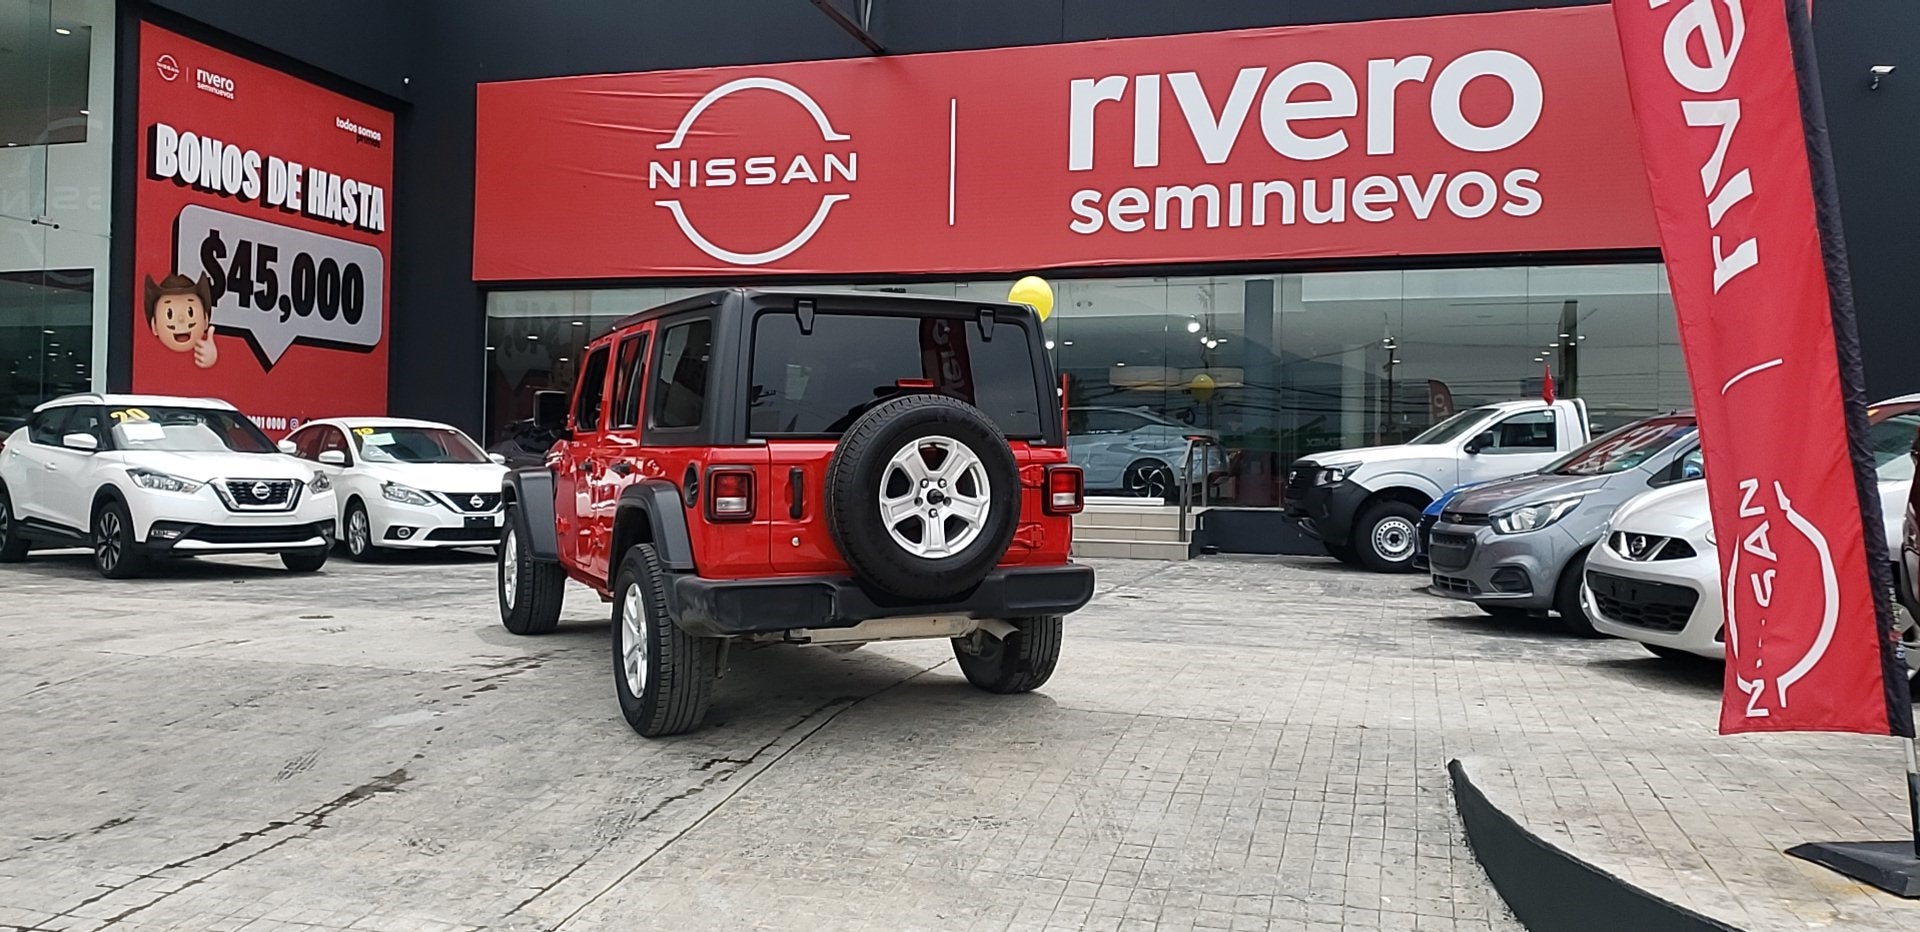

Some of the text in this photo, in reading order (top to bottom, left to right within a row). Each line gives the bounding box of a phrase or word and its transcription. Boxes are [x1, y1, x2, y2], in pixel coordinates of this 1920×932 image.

[197, 69, 234, 92] rivero
[336, 116, 382, 141] todos somos
[1069, 50, 1544, 171] rivero
[153, 123, 385, 232] BONOS DE HASTA
[649, 153, 857, 189] NISSAN
[1069, 169, 1543, 234] seminuevos
[200, 229, 364, 325] $45,000
[266, 417, 287, 430] 0000
